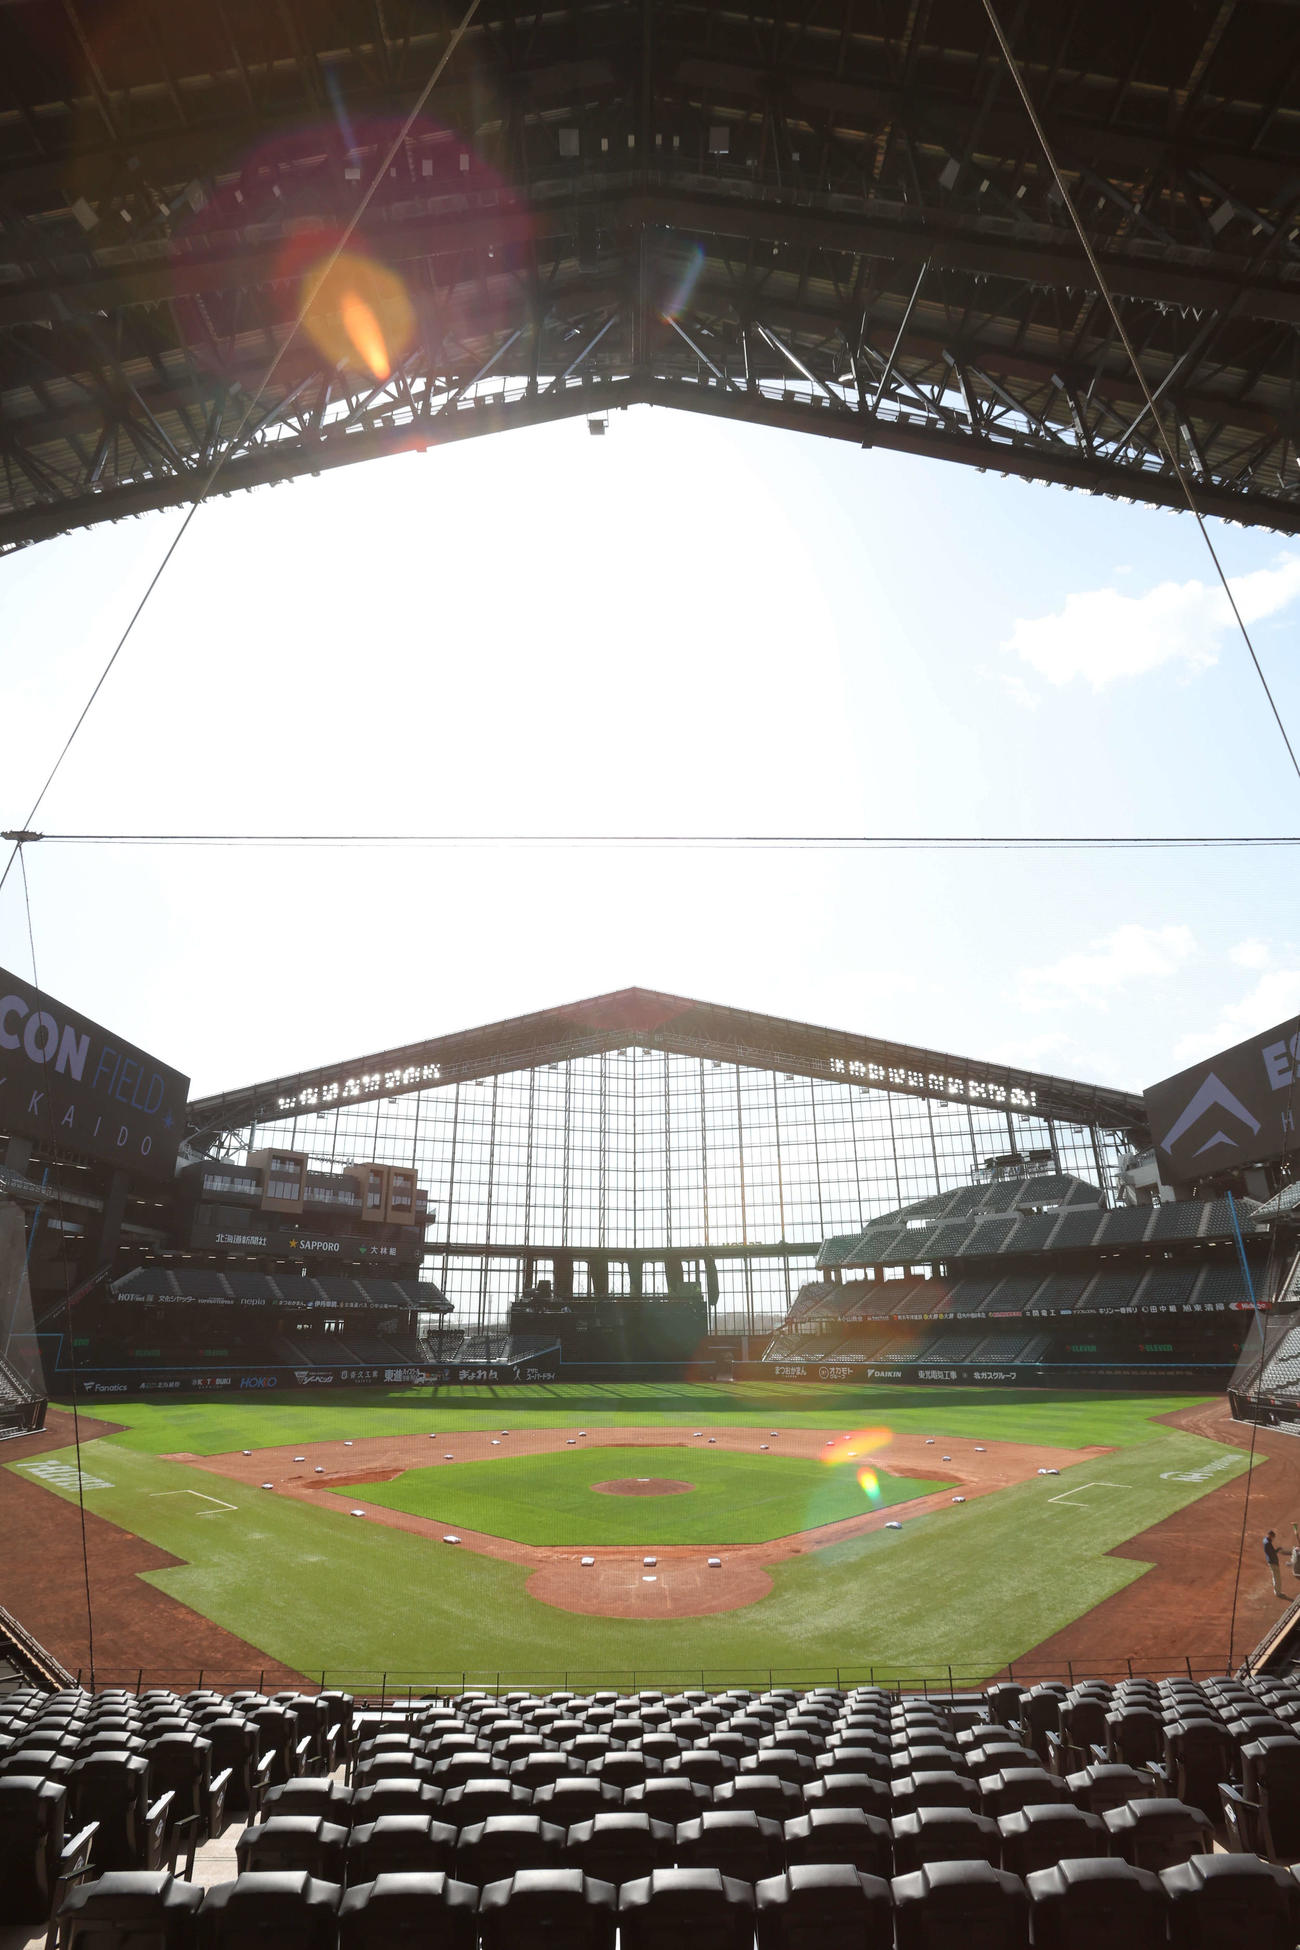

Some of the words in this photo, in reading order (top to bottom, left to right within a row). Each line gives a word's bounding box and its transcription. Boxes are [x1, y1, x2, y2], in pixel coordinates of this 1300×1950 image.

[0, 994, 91, 1081] CON
[92, 1046, 165, 1114] FIELD
[299, 1239, 340, 1252] SAPPORO
[240, 1297, 266, 1306] nepia
[459, 1369, 499, 1381] ぎょれん
[829, 1366, 854, 1375] オカモト
[874, 1370, 902, 1378] DAIKIN
[973, 1371, 1017, 1380] 北ガスグループ
[95, 1383, 128, 1392] Fanatics
